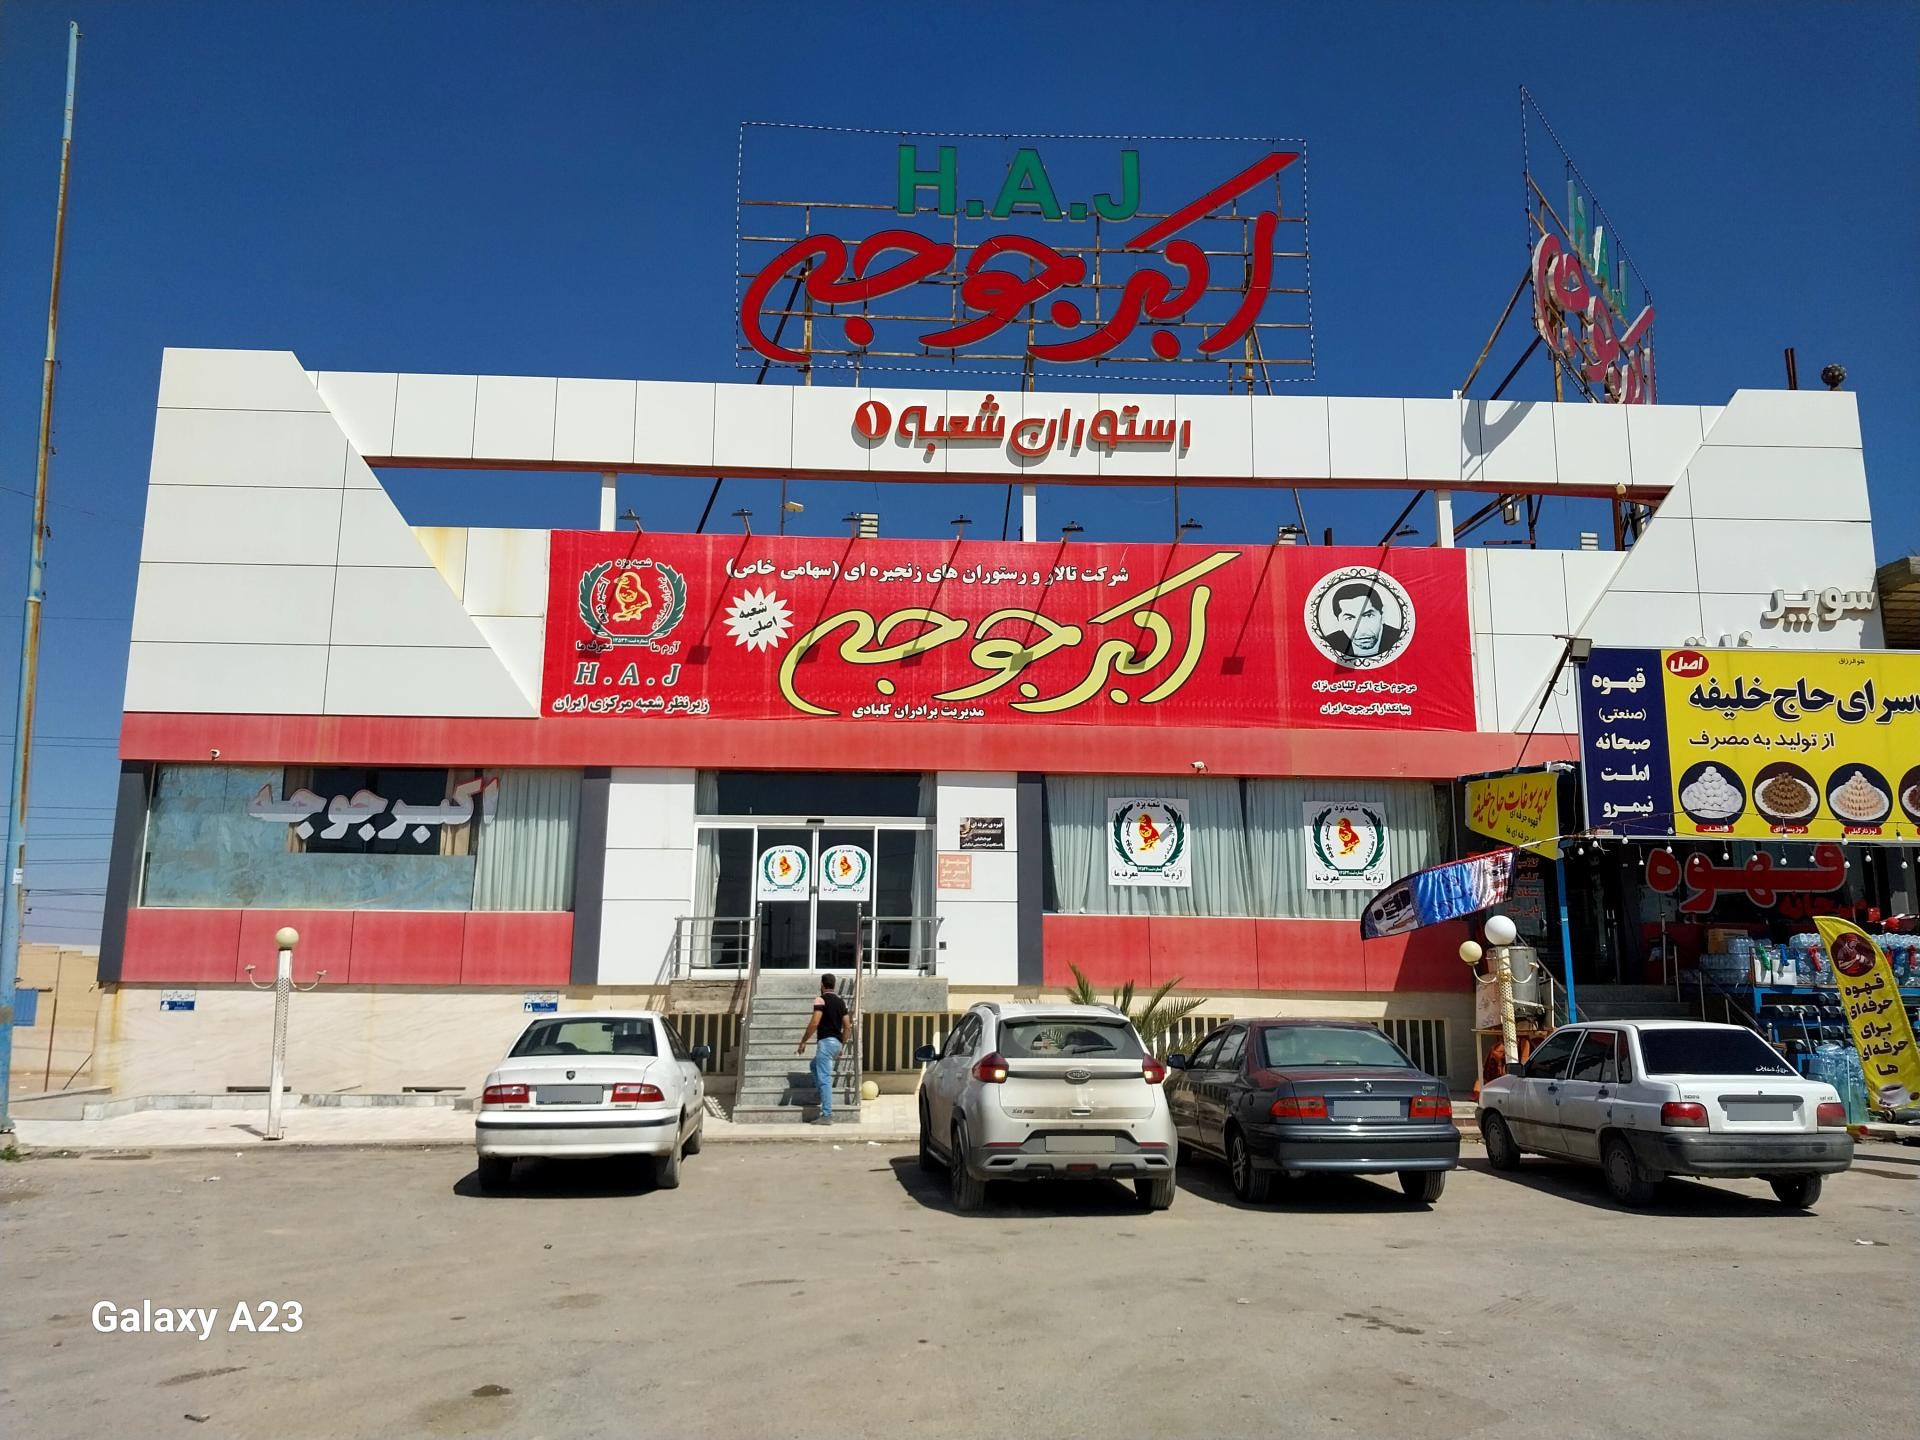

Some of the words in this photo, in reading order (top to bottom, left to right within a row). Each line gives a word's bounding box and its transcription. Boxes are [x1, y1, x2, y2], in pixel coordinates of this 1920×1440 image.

[896, 144, 1141, 224] H.A.J
[899, 393, 1006, 453] شعبه
[1010, 404, 1192, 457] رستوران
[616, 558, 631, 570] یزد
[632, 558, 652, 570] شعبه
[725, 558, 776, 579] خاص)
[780, 560, 840, 581] (سهامی
[844, 561, 866, 582] ای
[869, 561, 922, 582] زنجیره
[926, 562, 958, 584] های
[962, 563, 1026, 585] رستوران
[1031, 571, 1040, 585] و
[1046, 564, 1077, 585] تالار
[1081, 565, 1129, 586] شرکت
[738, 601, 768, 620] شعبه
[1762, 586, 1876, 623] سوپر
[748, 616, 779, 638] اصلی
[1008, 552, 1242, 714] اکبر
[778, 607, 1083, 716] جوجه
[1670, 656, 1704, 673] اصل
[1312, 680, 1329, 690] نژاد
[1329, 680, 1356, 692] کلبادی
[1355, 680, 1374, 693] اکبر
[1373, 681, 1389, 693] حاج
[1390, 680, 1417, 693] مرحوم
[1591, 667, 1646, 694] قهوه
[553, 694, 587, 713] ایران
[589, 694, 632, 712] مرکزی
[635, 696, 664, 711] شعبه
[1687, 675, 1773, 720] خلیفه
[1772, 676, 1836, 721] حاج
[851, 703, 892, 719] کلبادی
[894, 703, 938, 720] برادران
[941, 703, 985, 720] مدیریت
[1598, 707, 1647, 724] (صنعتی)
[1595, 732, 1651, 755] صبحانه
[1689, 730, 1749, 750] مصرف
[1752, 735, 1771, 751] به
[1774, 732, 1817, 752] تولید
[1820, 732, 1835, 750] از
[1600, 763, 1650, 782] املت
[1602, 795, 1654, 818] نیمرو
[1844, 973, 1885, 999] قهوه
[1860, 1020, 1893, 1040] برای
[1875, 1061, 1899, 1077] ها
